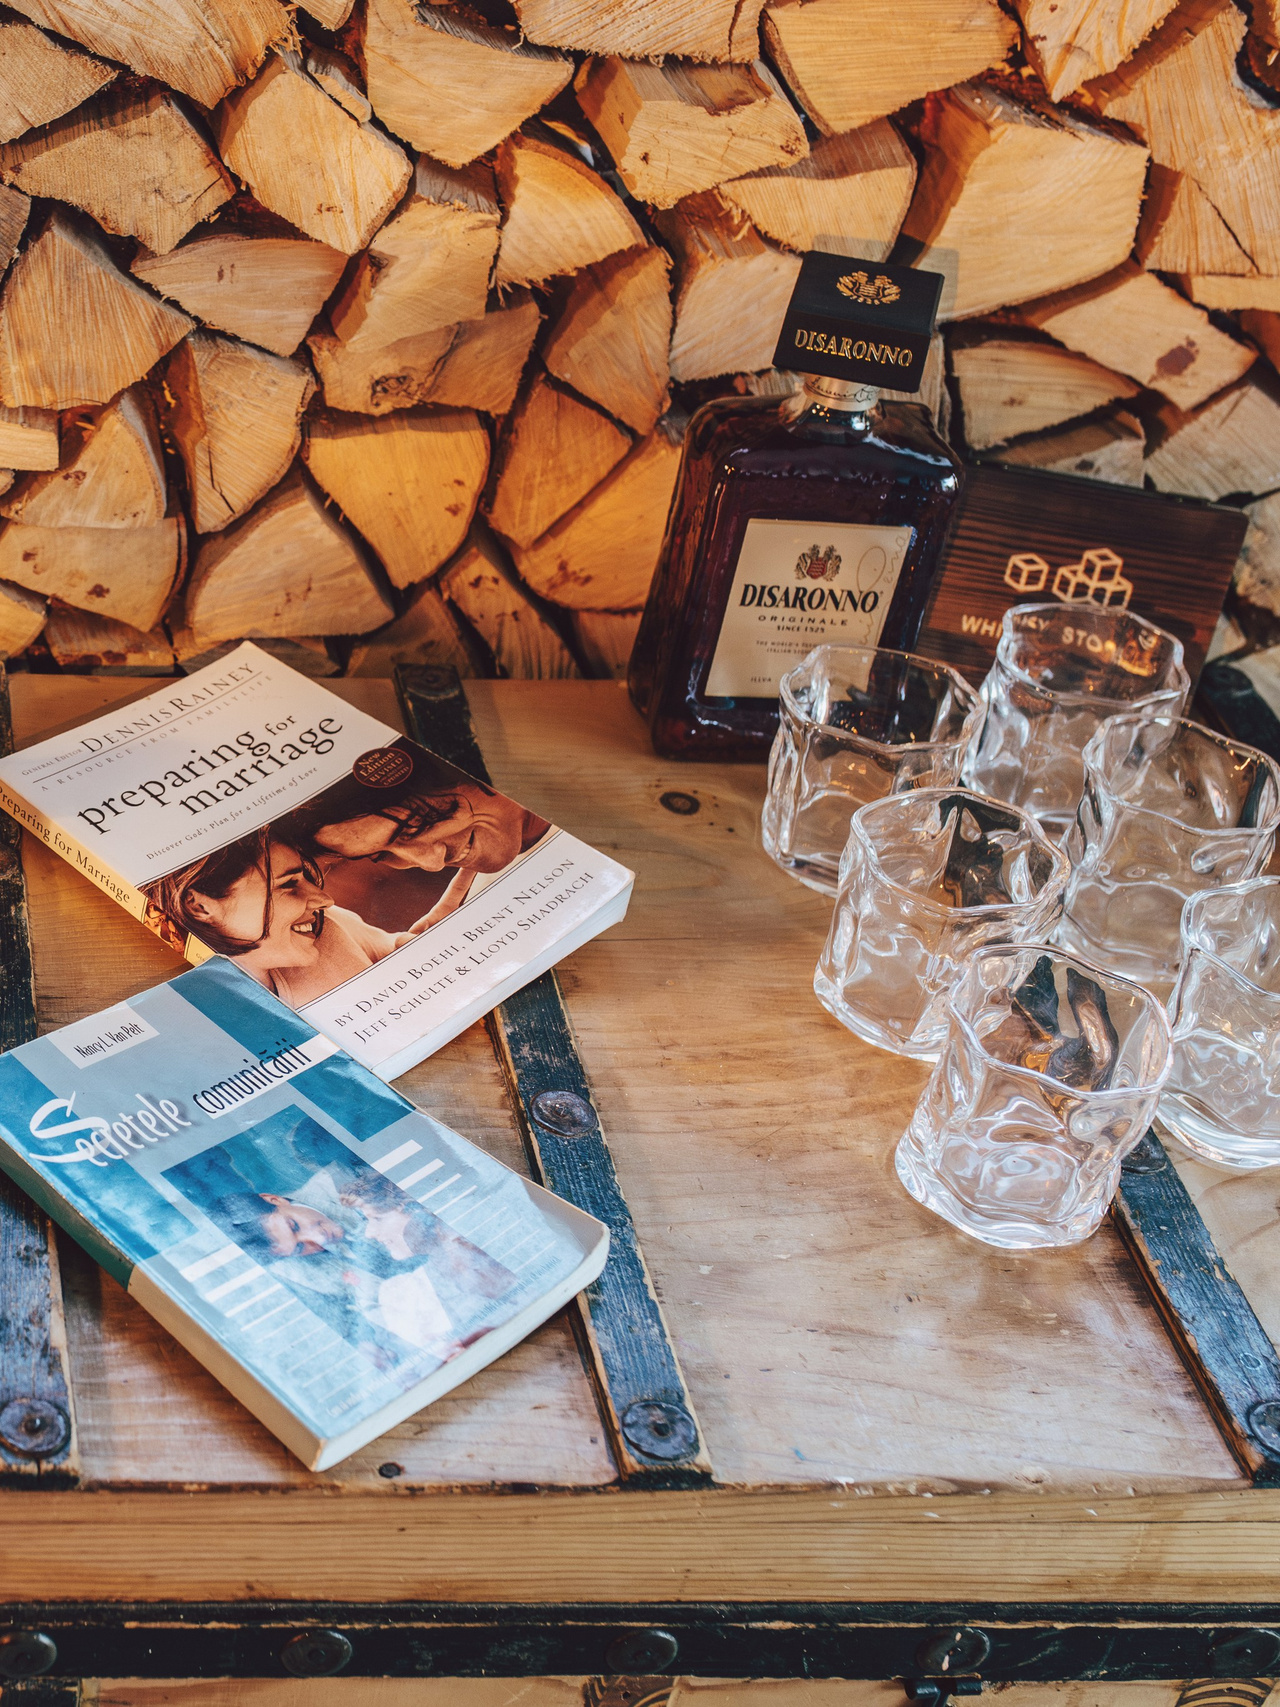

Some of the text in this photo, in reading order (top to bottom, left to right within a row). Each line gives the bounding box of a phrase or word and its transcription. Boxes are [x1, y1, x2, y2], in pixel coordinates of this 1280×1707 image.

[793, 328, 913, 367] DISARONNO
[737, 583, 881, 614] DISARONNO
[758, 614, 850, 626] ORIGINALE
[776, 625, 801, 633] SINCE
[21, 662, 254, 777] GENERAL EDITOR DENNIS RAINEY
[56, 748, 133, 785] RESOURCE
[140, 727, 180, 748] FROM
[76, 715, 298, 836] preparing for
[178, 716, 343, 816] marriage
[358, 752, 381, 768] New
[359, 752, 396, 777] Edition
[146, 766, 319, 860] Discover God's Plan for a Lifetime of Love
[53, 832, 72, 856] for
[75, 849, 132, 905] Marriage
[334, 1011, 355, 1028] BY
[355, 978, 408, 1015] DAVID
[462, 903, 516, 944] BRENT
[512, 857, 576, 907] NELSON
[352, 870, 596, 1046] JEFF SCHULTE & LLOYD SHADRACH
[73, 1022, 145, 1059] Nancy L. Van Pelt
[28, 1037, 314, 1168] Secretele comunicării
